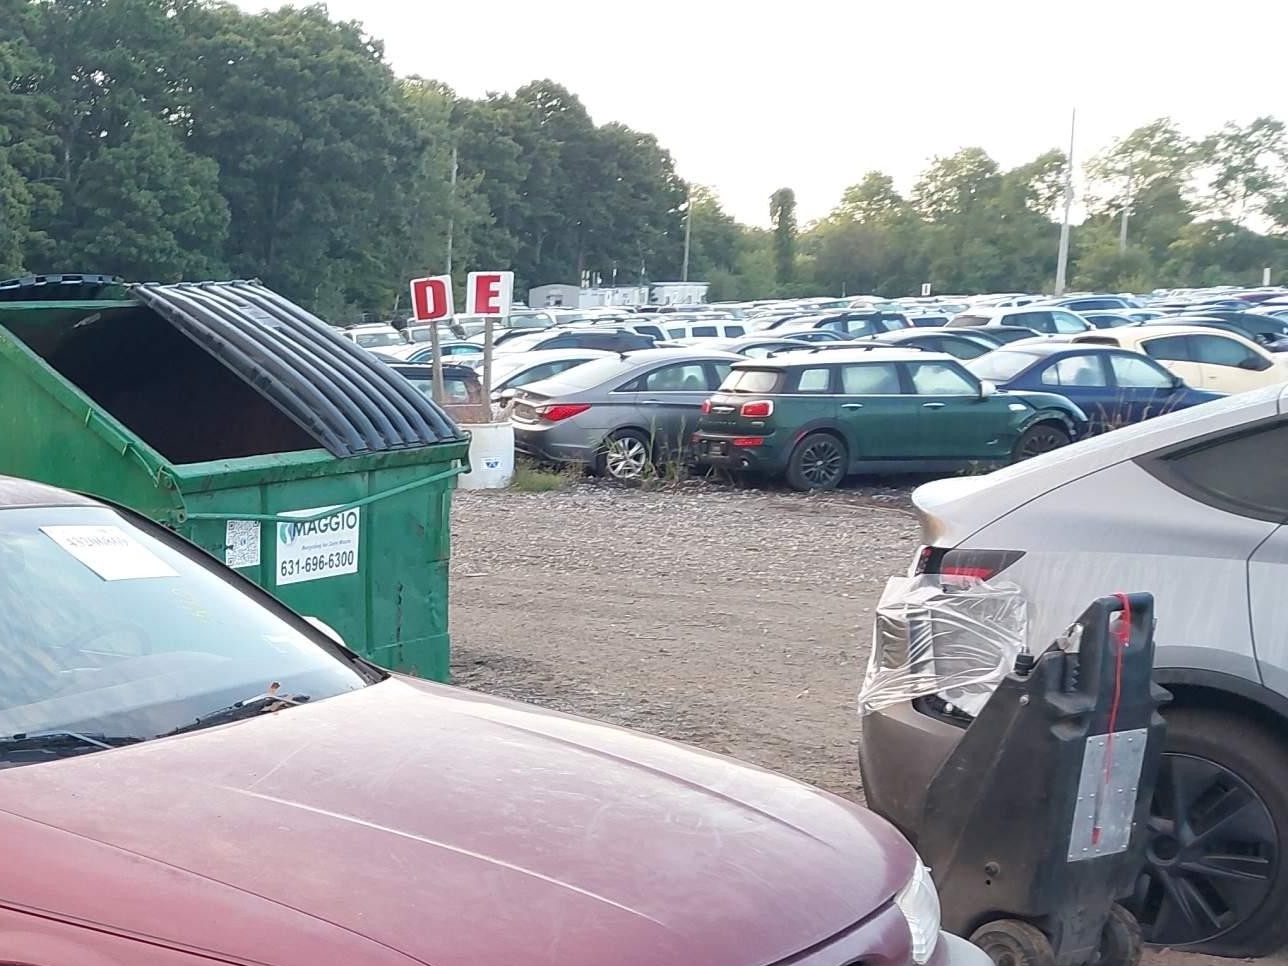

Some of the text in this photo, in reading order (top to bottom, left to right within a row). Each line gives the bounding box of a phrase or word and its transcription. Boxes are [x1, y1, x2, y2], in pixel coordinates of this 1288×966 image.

[414, 280, 447, 320] D
[474, 275, 500, 313] E
[295, 511, 358, 537] MAGGIO
[281, 550, 354, 577] 631-696-6300
